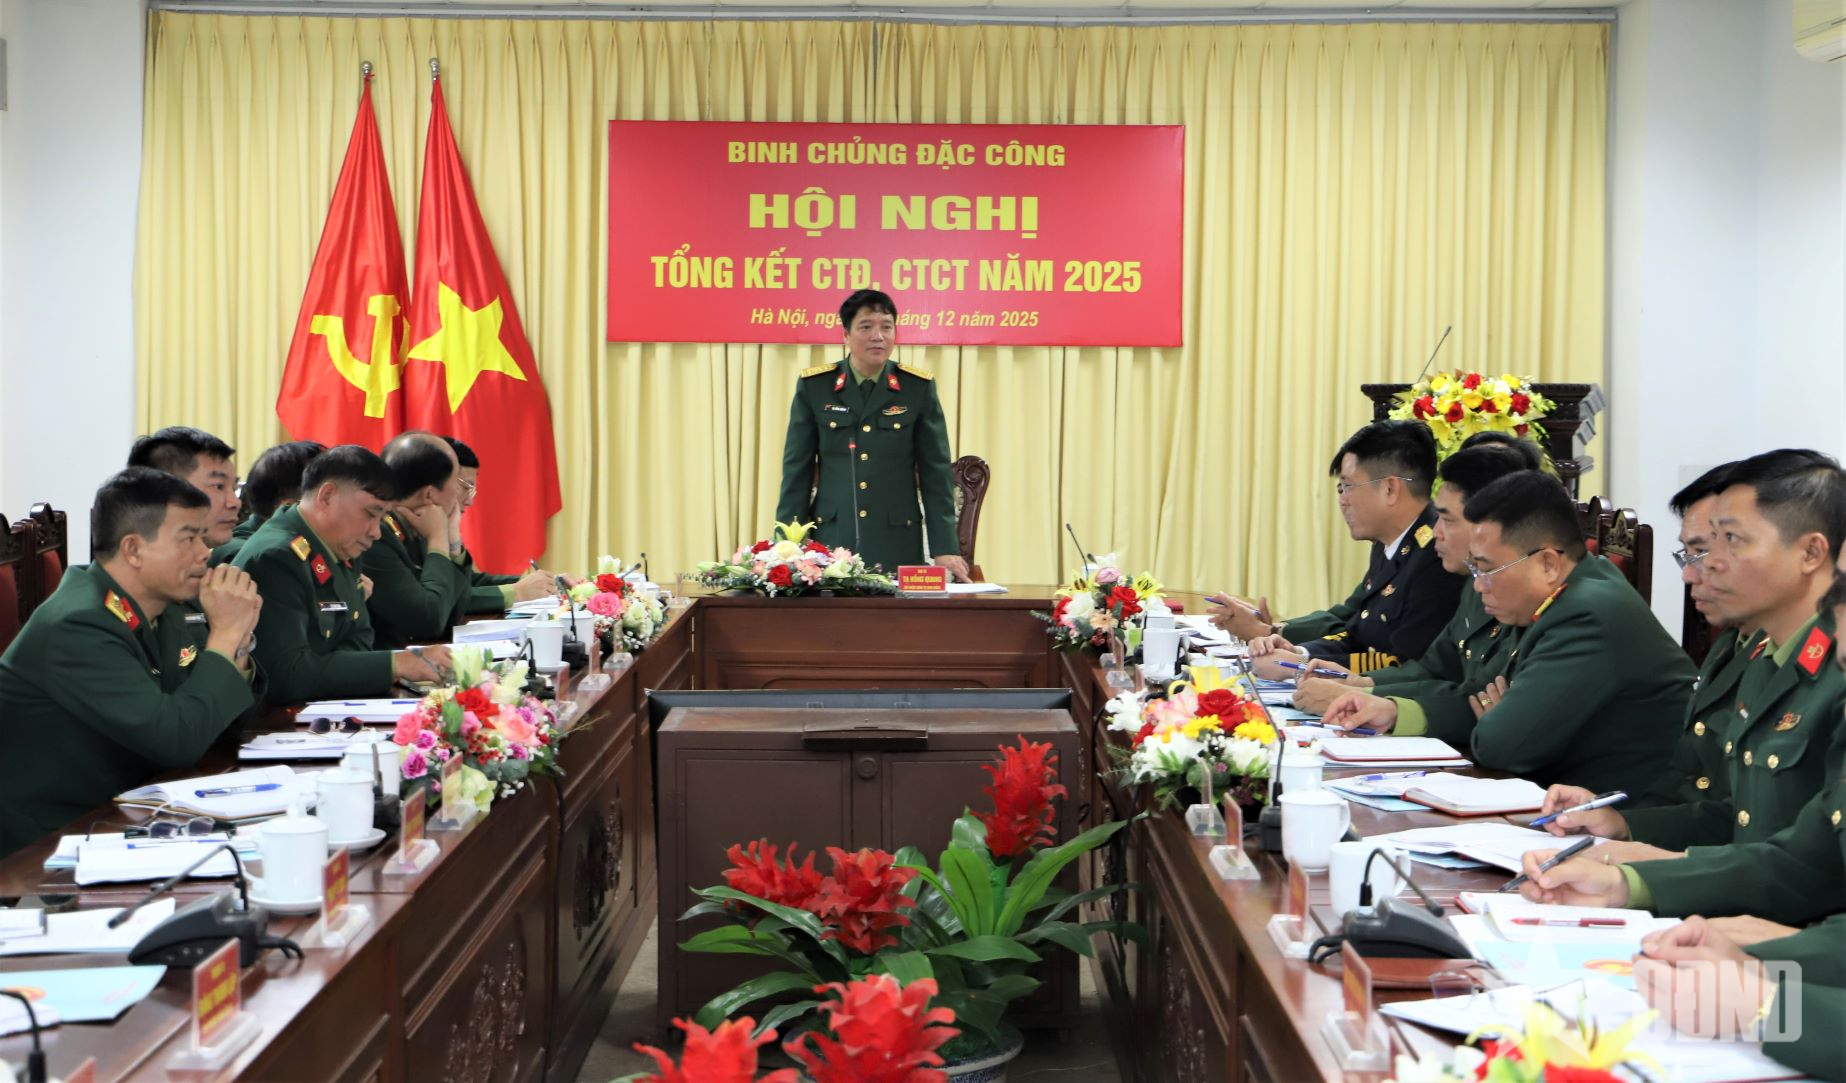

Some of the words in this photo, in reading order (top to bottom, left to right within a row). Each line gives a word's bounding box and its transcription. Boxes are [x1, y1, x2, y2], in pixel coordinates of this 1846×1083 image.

[728, 141, 798, 164] BINH
[807, 135, 907, 165] CHỦNG
[915, 140, 975, 170] ĐẶC
[985, 140, 1065, 167] CÔNG
[749, 186, 857, 237] HỘI
[880, 195, 1039, 240] NGHỊ
[650, 243, 734, 289] TỔNG
[744, 246, 803, 289] KẾT
[891, 257, 971, 292] CTCT
[978, 252, 1054, 292] NĂM
[1063, 259, 1142, 293] 2025
[750, 308, 774, 325] Hà
[777, 308, 809, 328] Nội,
[814, 312, 843, 329] ng
[895, 309, 932, 330] áng
[937, 311, 956, 327] 12
[959, 311, 996, 328] năm
[999, 310, 1039, 328] 2025
